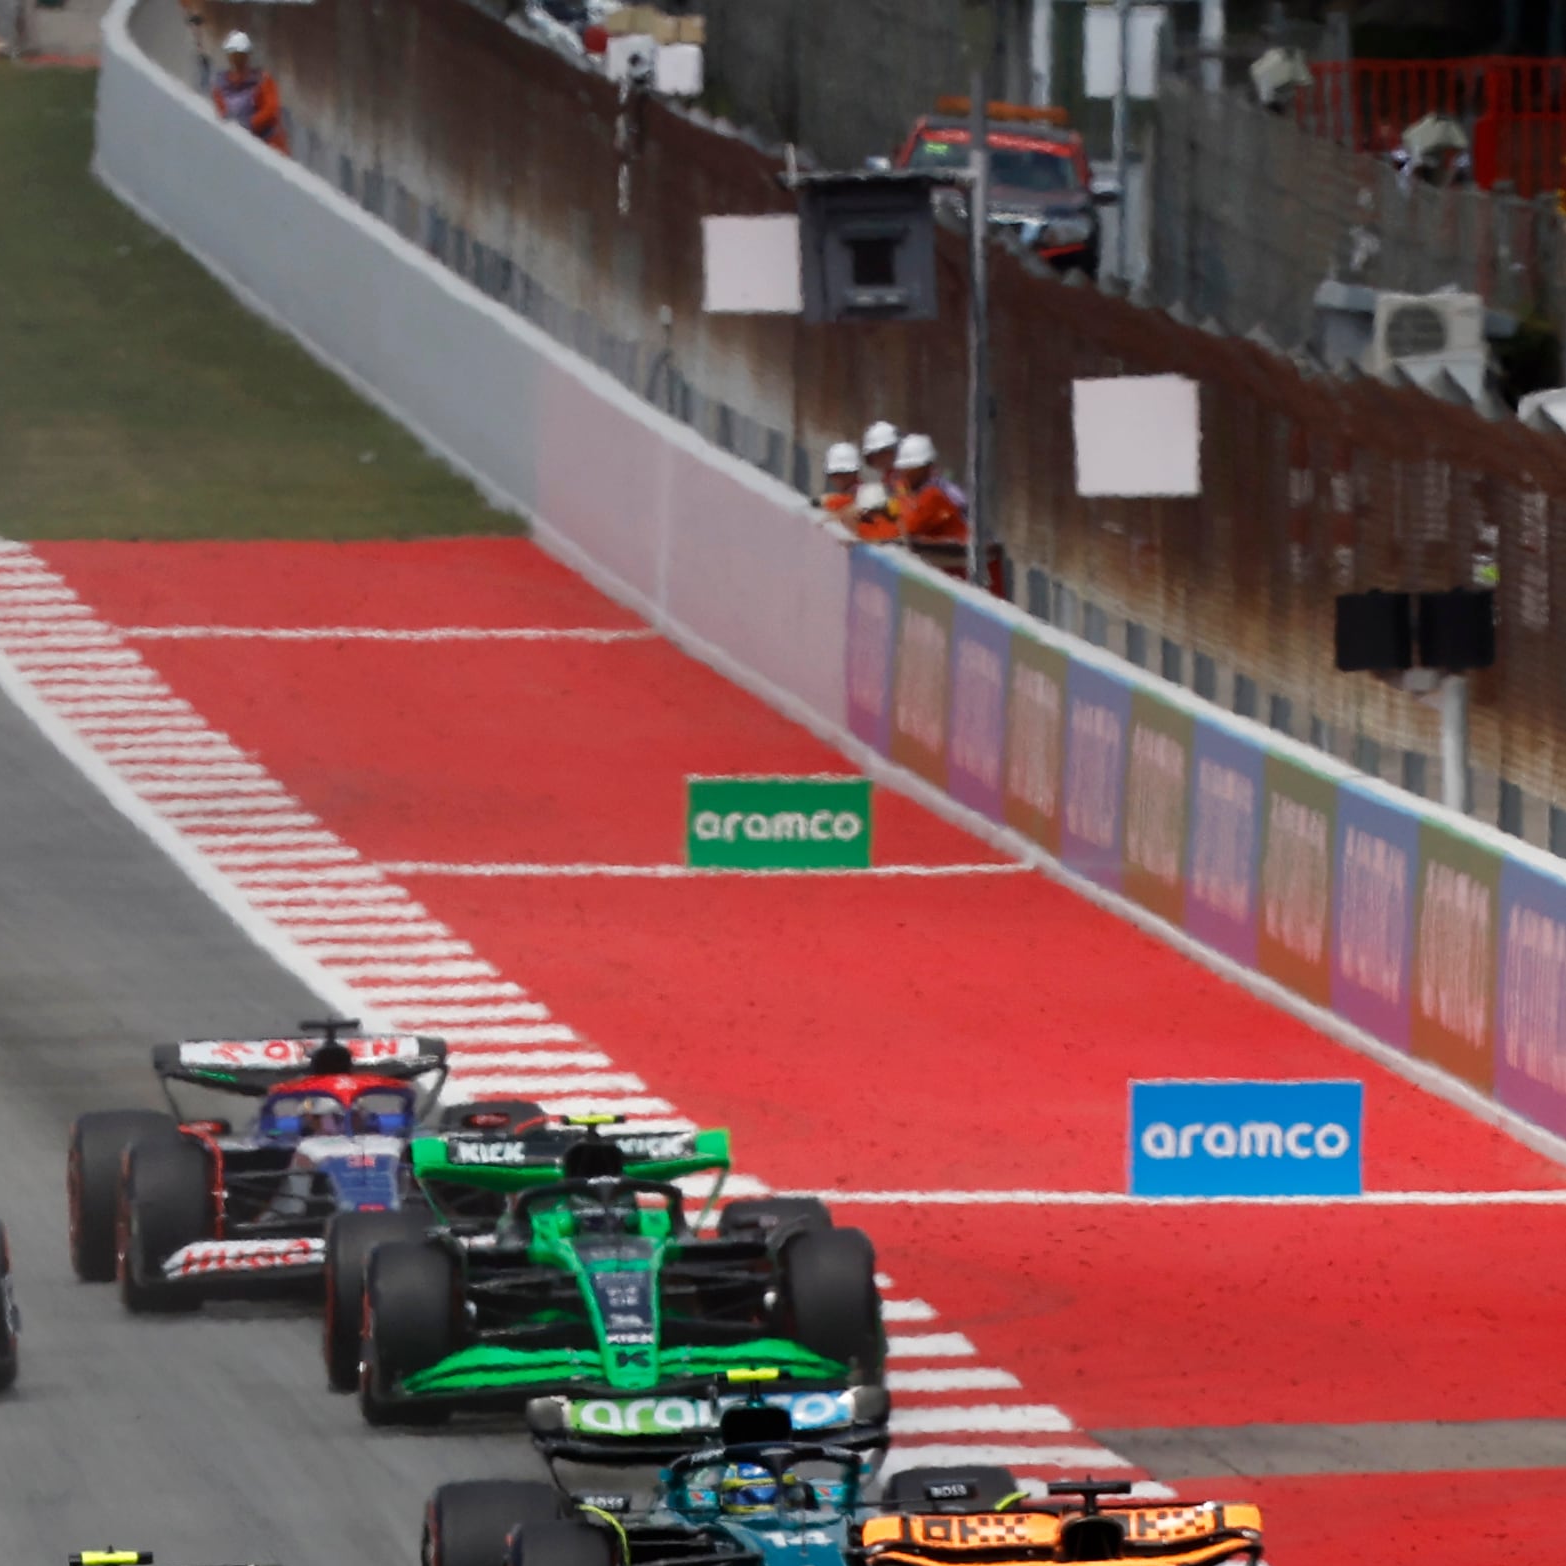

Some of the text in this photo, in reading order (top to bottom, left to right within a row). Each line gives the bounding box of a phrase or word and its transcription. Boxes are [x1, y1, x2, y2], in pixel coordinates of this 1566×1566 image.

[694, 810, 862, 842] aramco
[455, 1140, 526, 1164] KICK
[1141, 1120, 1350, 1159] aramco
